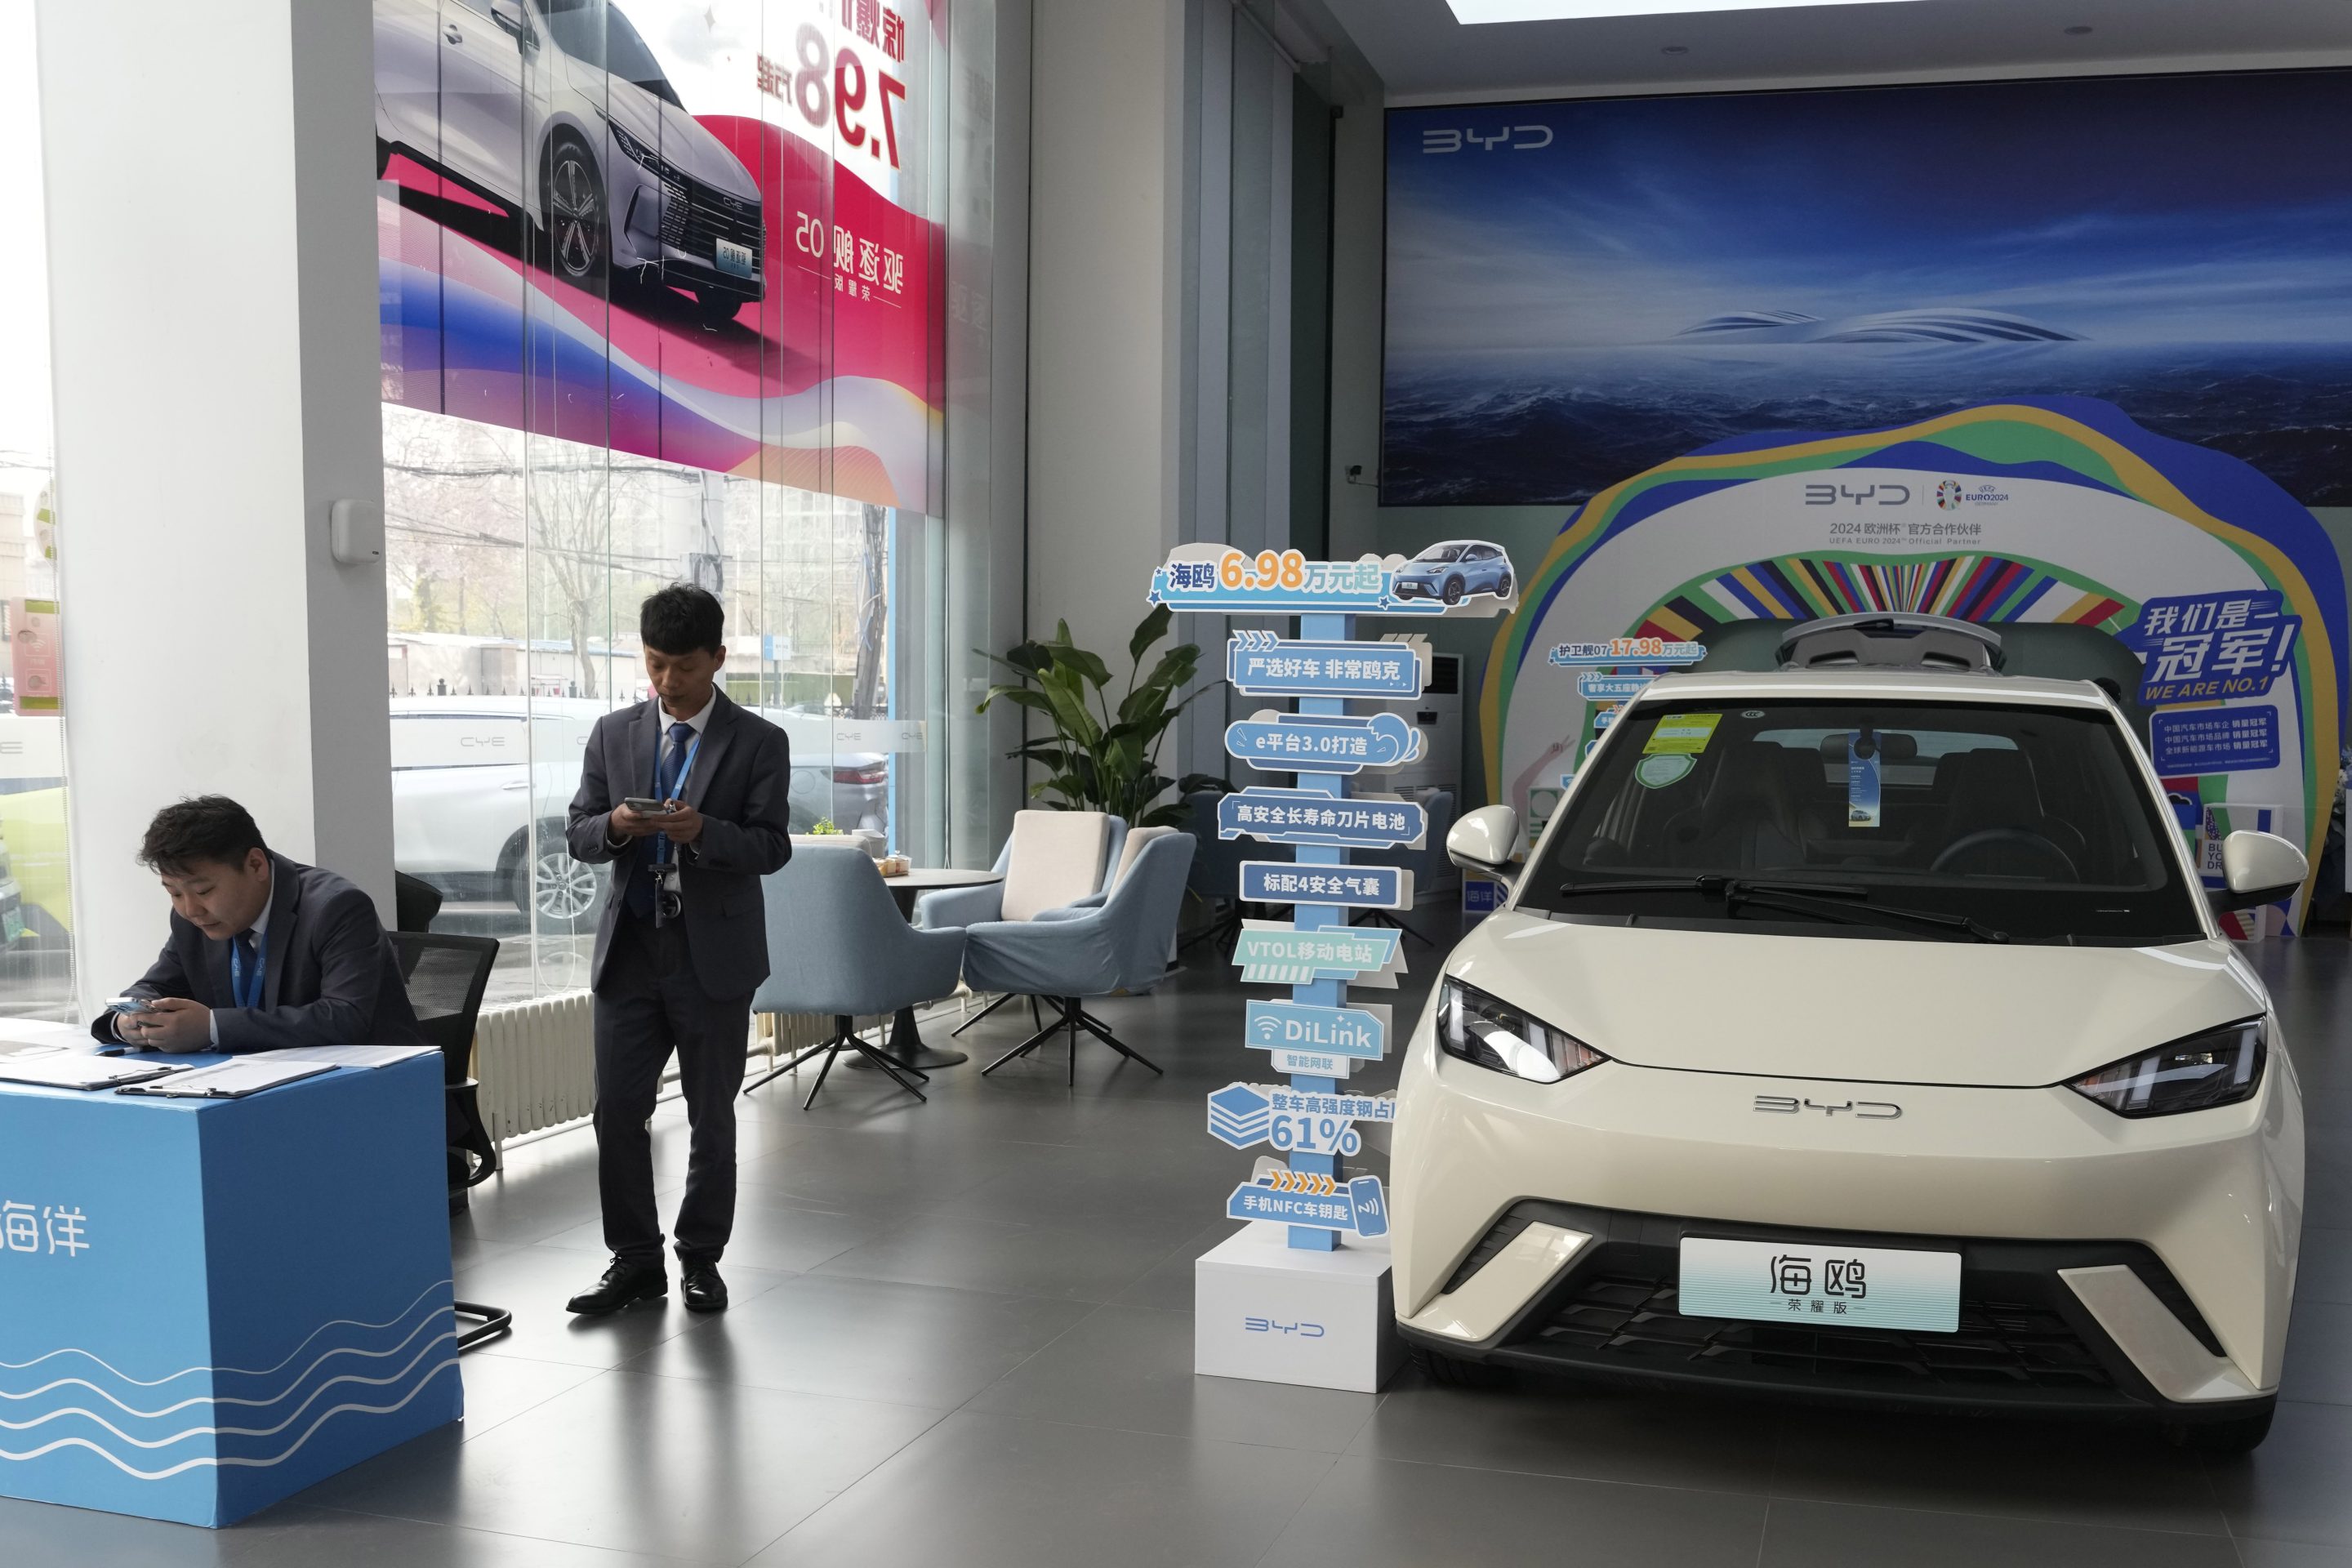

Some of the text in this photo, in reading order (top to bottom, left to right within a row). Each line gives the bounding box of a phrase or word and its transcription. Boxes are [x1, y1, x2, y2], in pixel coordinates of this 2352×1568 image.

[1423, 125, 1554, 154] BYD
[1806, 484, 1910, 506] BYD
[1829, 523, 1862, 534] 2024
[1908, 523, 1982, 536] 官方合作伙伴
[1909, 537, 1942, 546] Official
[1947, 537, 1981, 546] Partner
[1248, 657, 1401, 680] 严选好车 非常鸥克
[2146, 676, 2269, 700] WE ARE NO.1
[1256, 733, 1367, 755] e平台3.0打造
[1237, 804, 1405, 831] 高安全长寿命刀片电池
[1263, 873, 1380, 896] 标配4安全气囊
[1247, 941, 1372, 964] VTOL移动电站
[1285, 1019, 1372, 1048] DiLink
[1286, 1054, 1334, 1070] 智能网联
[1753, 1095, 1902, 1120] BYD
[1271, 1114, 1358, 1153] 61%
[1243, 1195, 1348, 1221] 手机NFC车钥匙
[1771, 1254, 1867, 1299] 海鸥
[1788, 1298, 1848, 1315] 荣耀版
[1245, 1317, 1325, 1338] BYD
